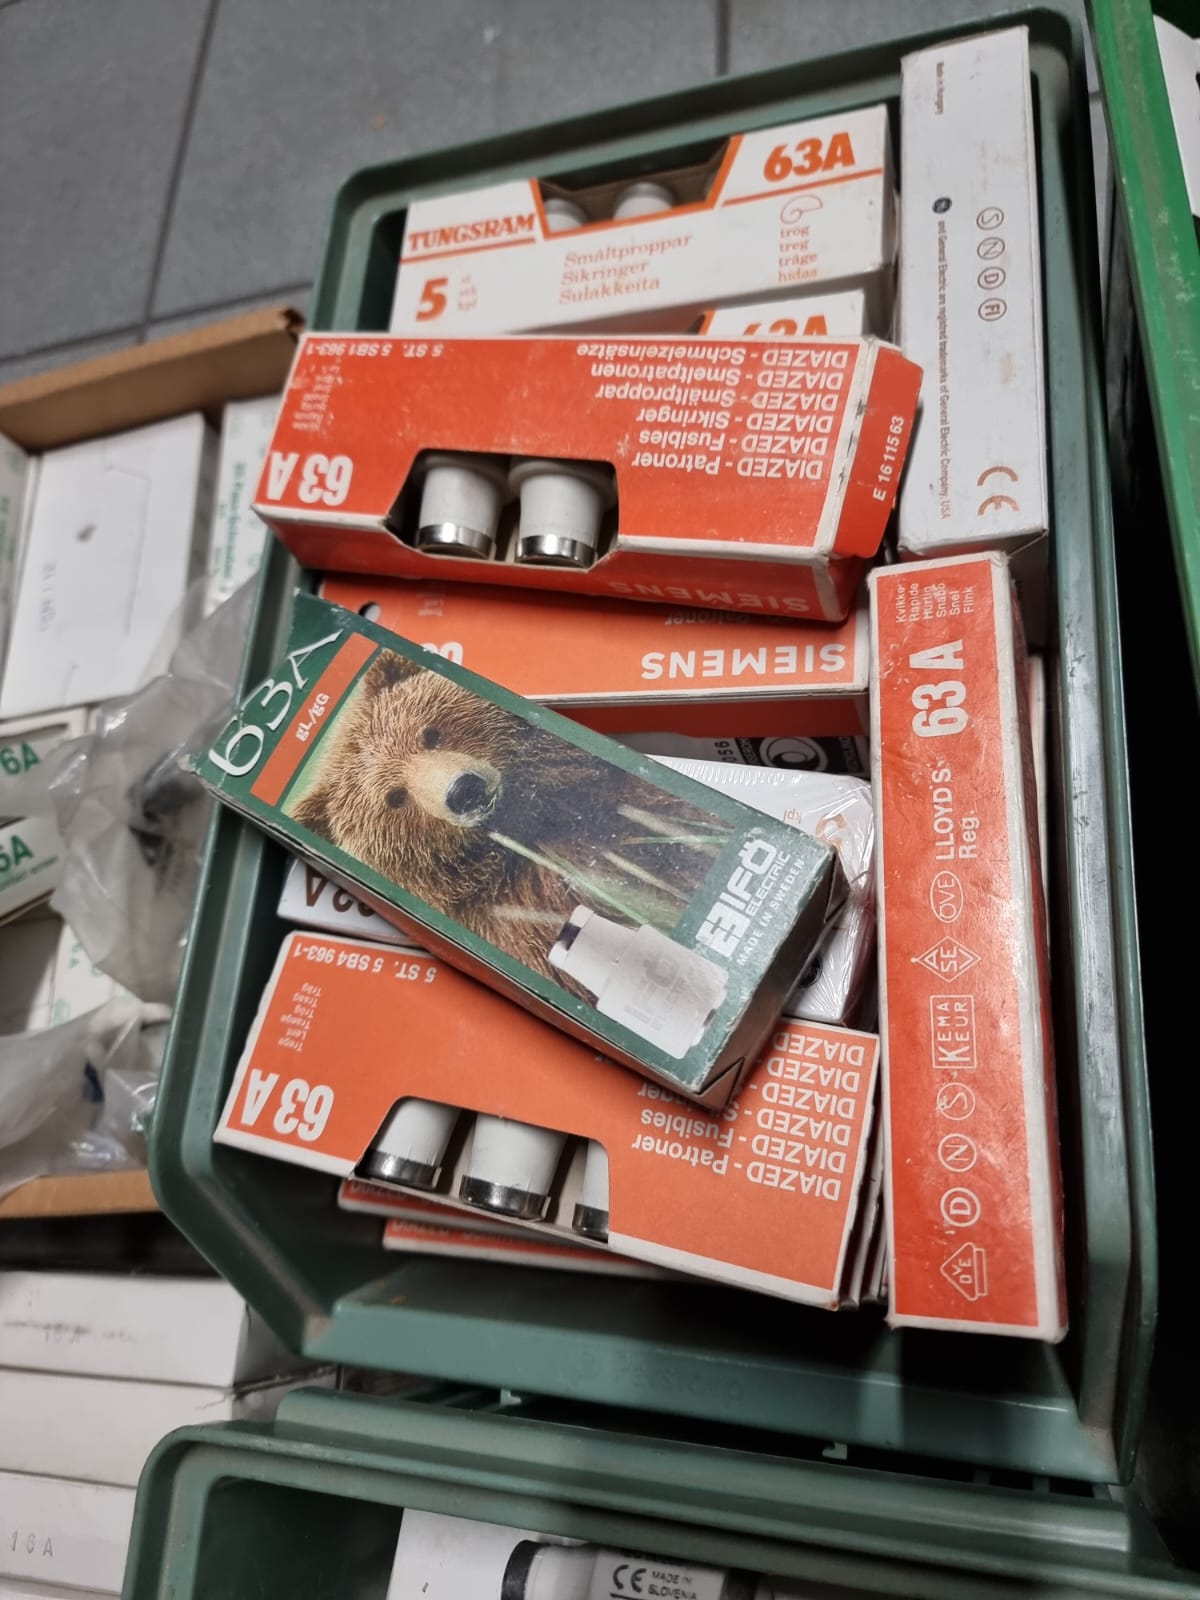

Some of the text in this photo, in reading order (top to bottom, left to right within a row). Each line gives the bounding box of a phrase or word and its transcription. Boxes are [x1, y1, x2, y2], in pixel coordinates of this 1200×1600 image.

[764, 131, 855, 182] 63A
[408, 212, 536, 251] TUNGSRAM
[778, 239, 810, 253] treg
[938, 235, 947, 263] General
[561, 262, 649, 286] Sikringer
[777, 267, 819, 283] hidas
[938, 264, 947, 292] Electric
[415, 277, 449, 322] 5
[558, 277, 661, 305] Sulakkeita
[431, 344, 444, 358] 5
[576, 344, 747, 365] Schmelzeinsätze
[761, 349, 849, 369] DIAZED
[938, 341, 948, 384] trademarks
[589, 363, 742, 387] Smeltpatronen
[757, 370, 844, 390] DIAZED
[594, 384, 737, 408] Smältproppar
[751, 390, 839, 412] DIAZED
[635, 407, 731, 429] Sikringer
[746, 412, 834, 434] DIAZED
[940, 395, 949, 426] General
[638, 429, 726, 451] Fusibles
[740, 435, 828, 456] DIAZED
[940, 426, 950, 457] Electric
[631, 452, 721, 475] Patroner
[735, 458, 824, 480] DIAZED
[871, 486, 887, 503] E
[940, 501, 950, 519] USA
[607, 580, 810, 615] SIEMENS
[908, 583, 920, 623] Rapide
[949, 590, 961, 616] Snel
[963, 586, 976, 614] Flink
[640, 644, 847, 680] SIEMENS
[208, 628, 344, 777] 63A
[929, 767, 955, 861] LLOYD'S
[956, 810, 980, 860] Reg.
[745, 850, 792, 917] ELECTRIC
[736, 857, 806, 966] MADE IN SWEDEN
[292, 942, 438, 984] 5 ST. 5 SB4 963-1
[772, 1031, 866, 1066] DIAZED
[766, 1056, 861, 1092] DIAZED
[761, 1081, 856, 1119] DIAZED
[640, 1108, 734, 1149] Fusibles
[756, 1107, 851, 1146] DIAZED
[631, 1133, 730, 1176] Patroner
[751, 1133, 847, 1174] DIAZED
[747, 1161, 841, 1202] DIAZED
[652, 1570, 681, 1585] MADE
[647, 1584, 698, 1600] SLOVENIA
